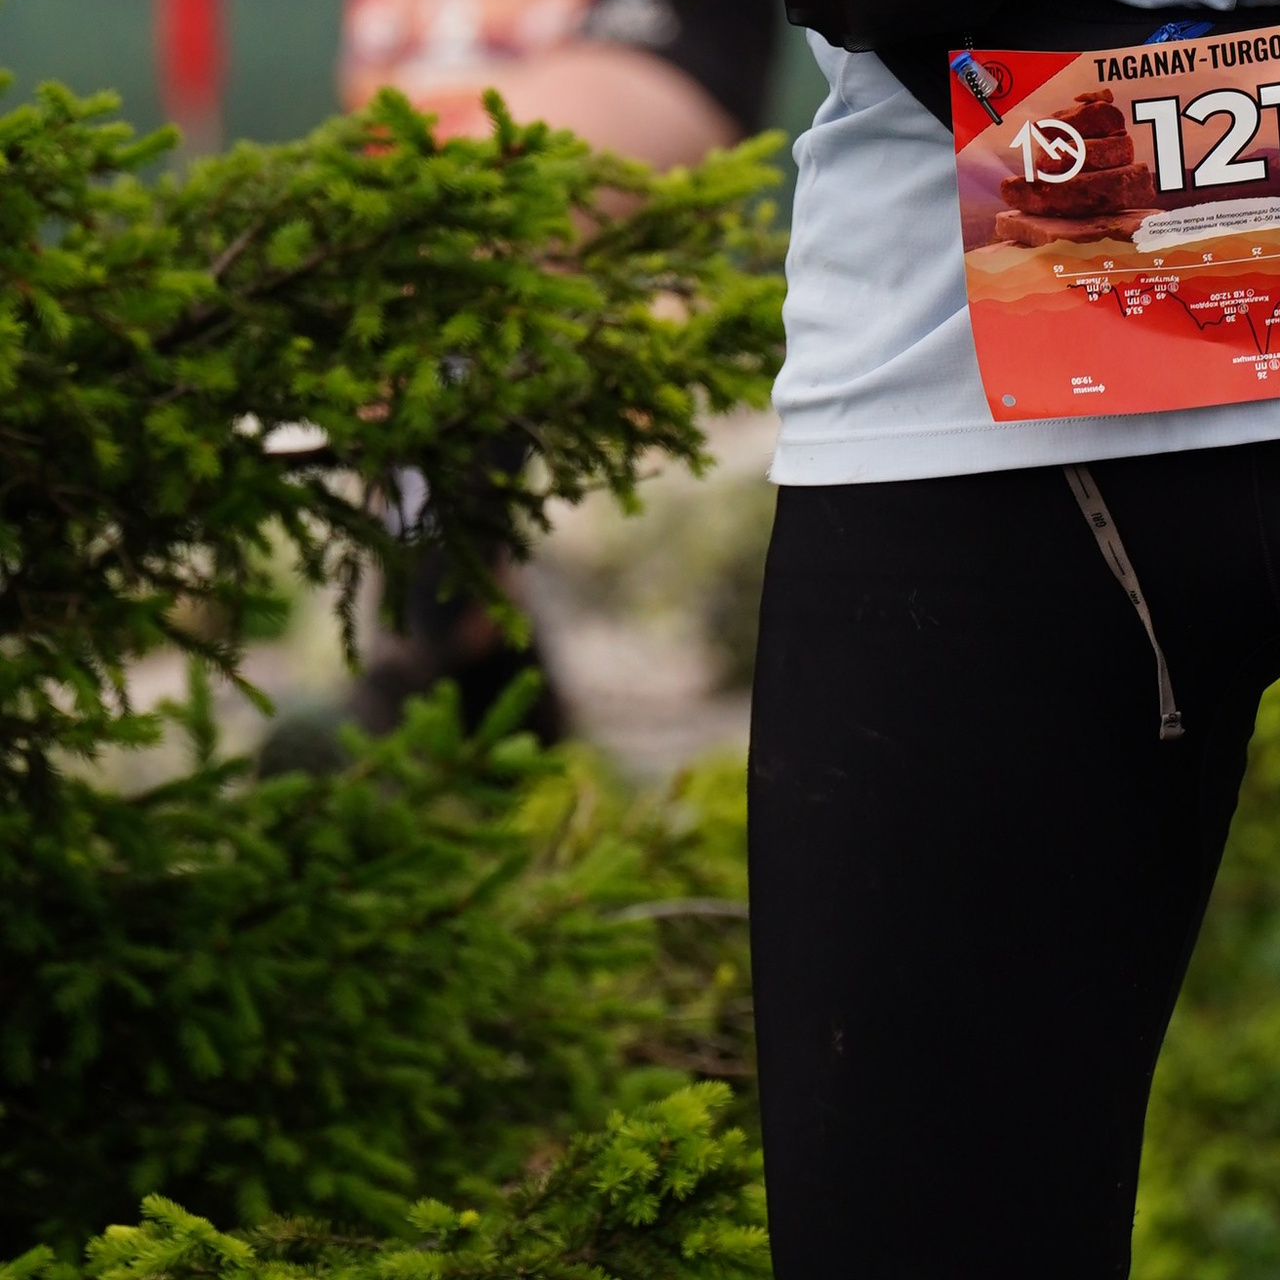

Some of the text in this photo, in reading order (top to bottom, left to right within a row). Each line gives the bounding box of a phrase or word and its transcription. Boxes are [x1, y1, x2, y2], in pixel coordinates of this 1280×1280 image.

[1148, 220, 1182, 228] Скорость
[1215, 209, 1268, 220] Метеостанции
[1148, 227, 1181, 235] скорости
[1251, 247, 1262, 256] 25
[1153, 258, 1164, 266] 45
[1202, 253, 1213, 262] 35
[1053, 265, 1064, 273] 65
[1103, 261, 1114, 269] 55
[1076, 277, 1101, 285] Лысая
[1140, 275, 1180, 284] Куштумга
[1086, 284, 1099, 293] ПП
[1154, 284, 1167, 292] ПП
[1088, 293, 1099, 301] 61
[1124, 289, 1141, 297] ЛЭП
[1155, 292, 1166, 300] 49
[1210, 289, 1245, 301] КВ 12:00
[1127, 297, 1140, 305] ПП
[1190, 295, 1269, 309] Киалимский кордон
[1126, 306, 1143, 315] 53,6
[1224, 306, 1237, 315] ПП
[1225, 314, 1236, 323] 30
[1255, 362, 1267, 371] ПП
[1257, 371, 1267, 380] 26
[1071, 376, 1093, 386] 19:00
[1073, 384, 1105, 395] финиш
